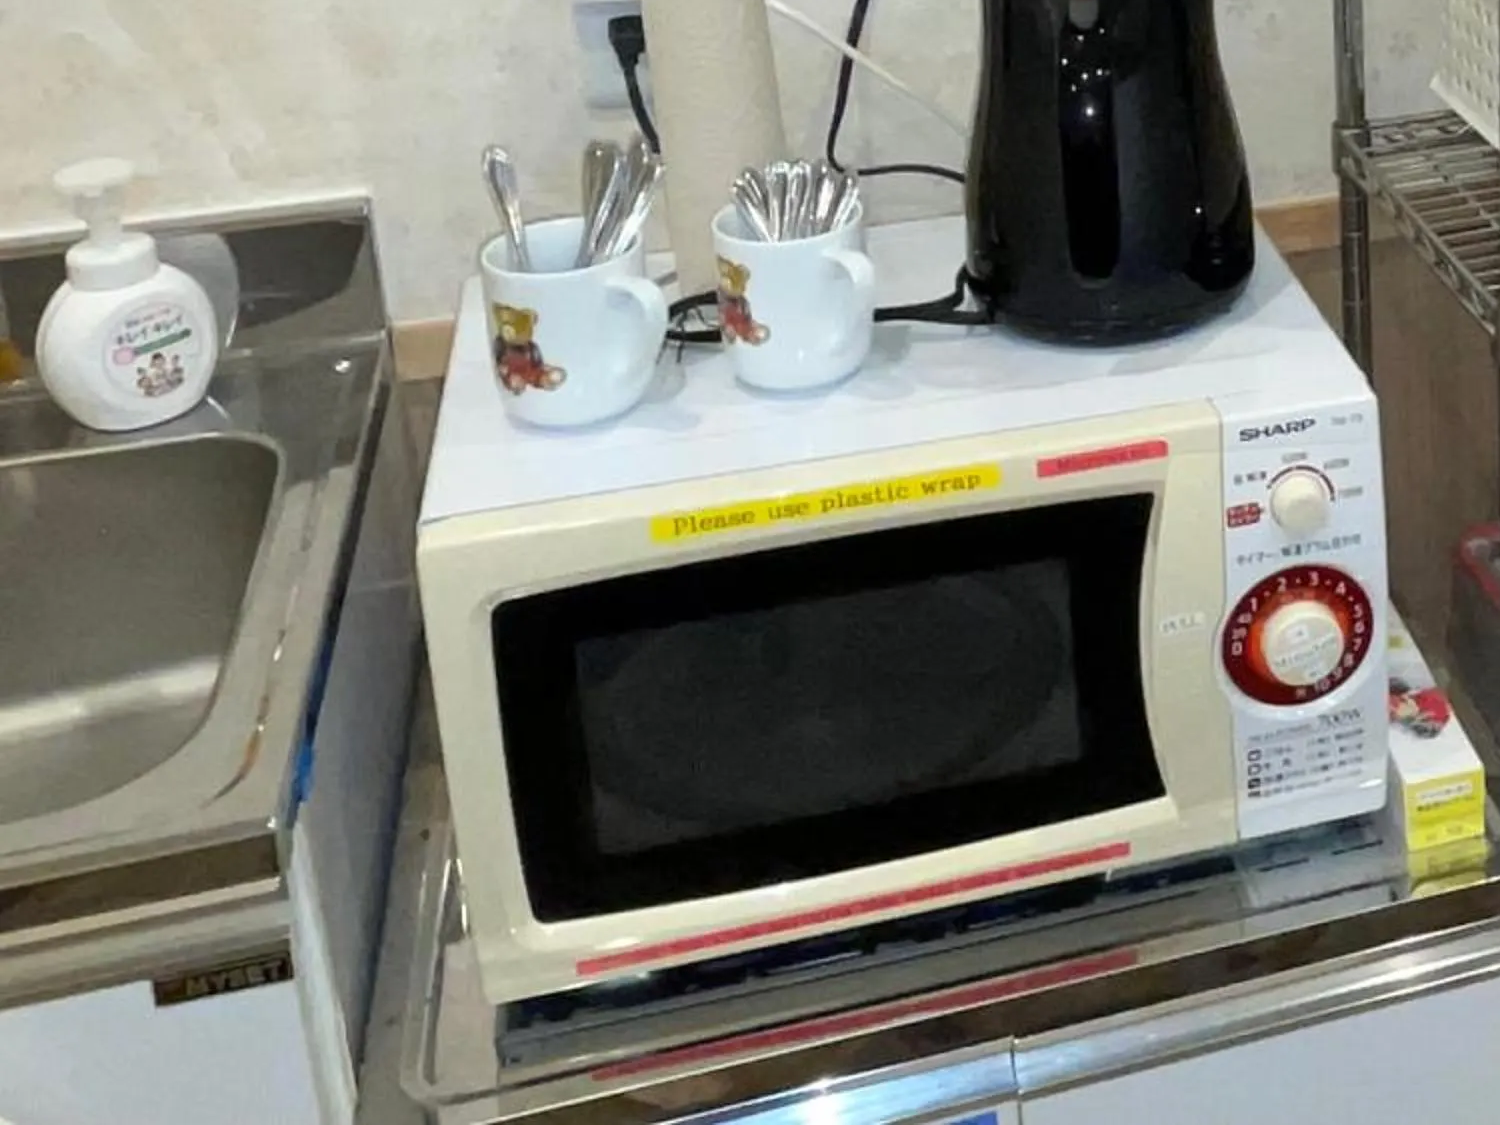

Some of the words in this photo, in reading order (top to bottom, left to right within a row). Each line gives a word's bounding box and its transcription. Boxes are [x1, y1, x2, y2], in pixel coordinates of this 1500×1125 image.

[1239, 418, 1316, 442] SHARP
[673, 509, 755, 536] Please
[768, 501, 810, 520] use
[820, 482, 909, 514] plastic
[920, 472, 982, 494] wrap
